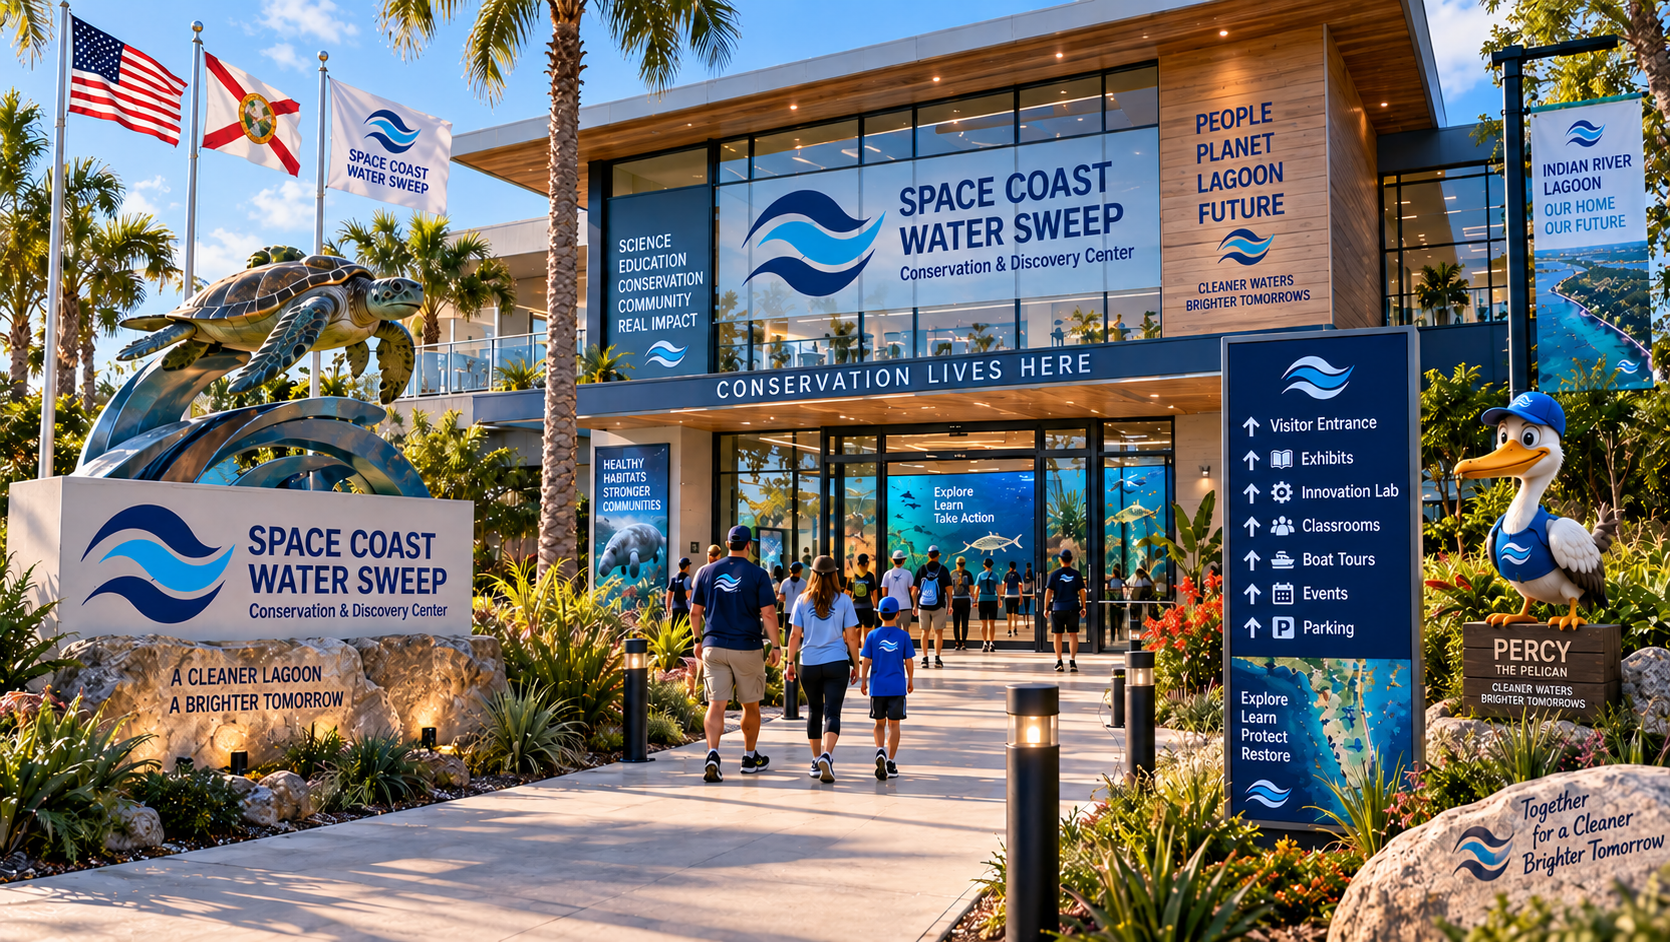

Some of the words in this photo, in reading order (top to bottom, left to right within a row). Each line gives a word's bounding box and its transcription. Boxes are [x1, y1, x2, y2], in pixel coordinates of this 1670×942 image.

[1196, 102, 1272, 134] PEOPLE
[1197, 132, 1274, 164] PLANET
[349, 148, 387, 170] SPACE
[390, 160, 429, 180] COAST
[1543, 159, 1589, 177] INDIAN
[1593, 154, 1631, 171] RIVER
[347, 164, 386, 186] WATER
[388, 175, 429, 194] SWEEP
[1198, 161, 1283, 194] LAGOON
[1544, 176, 1602, 195] LAGOON
[899, 177, 995, 216] SPACE
[1006, 161, 1112, 203] COAST
[1198, 193, 1284, 224] FUTURE
[1544, 200, 1571, 216] OUR
[1575, 197, 1615, 213] HOME
[900, 216, 1004, 255] WATER
[1014, 203, 1124, 243] SWEEP
[1545, 219, 1572, 235] OUR
[1575, 215, 1626, 232] FUTURE
[619, 234, 671, 253] SCIENCE
[619, 252, 687, 273] EDUCATION
[900, 259, 991, 281] Conservation
[996, 257, 1006, 271] &
[1011, 250, 1081, 271] Discovery
[1085, 245, 1135, 263] Center
[618, 270, 703, 294] CONSERVATION
[1198, 278, 1247, 295] CLEANER
[1250, 274, 1294, 290] WATERS
[618, 293, 692, 313] COMMUNITY
[1186, 294, 1237, 311] BRIGHTER
[1239, 289, 1310, 307] TOMORROWS
[618, 317, 648, 333] REAL
[651, 312, 697, 330] IMPACT
[717, 368, 910, 399] CONSERVATION
[927, 360, 1001, 383] LIVES
[1020, 354, 1092, 377] HERE
[1270, 418, 1314, 433] Visitor
[1318, 415, 1377, 430] Entrance
[604, 458, 644, 470] HEALTHY
[1301, 450, 1353, 466] Exhibits
[604, 472, 646, 483] HABITATS
[603, 486, 650, 498] STRONGER
[934, 487, 973, 499] Explore
[1302, 484, 1371, 499] Innovation
[1375, 483, 1398, 497] Lab
[603, 500, 661, 511] COMMUNITIES
[934, 500, 963, 510] Learn
[934, 513, 959, 524] Take
[961, 513, 994, 523] Action
[1302, 518, 1380, 532] Classrooms
[248, 525, 341, 557] SPACE
[351, 530, 436, 560] COAST
[1303, 553, 1333, 567] Boat
[1337, 551, 1375, 566] Tours
[249, 564, 348, 594] WATER
[357, 566, 447, 595] SWEEP
[1303, 586, 1348, 600] Events
[249, 602, 335, 619] Conservation
[340, 603, 349, 618] &
[353, 603, 407, 620] Discovery
[412, 603, 447, 617] Center
[1303, 620, 1354, 638] Parking
[1494, 638, 1571, 662] PERCY
[171, 668, 182, 686] A
[188, 667, 257, 686] CLEANER
[263, 666, 322, 683] LAGOON
[1495, 665, 1516, 675] THE
[1520, 665, 1568, 677] PELICAN
[1492, 683, 1532, 693] CLEANER
[1536, 685, 1572, 695] WATERS
[169, 695, 180, 714] A
[186, 693, 258, 713] BRIGHTER
[263, 691, 344, 710] TOMORROW
[1241, 691, 1288, 708] Explore
[1481, 694, 1524, 705] BRIGHTER
[1527, 697, 1585, 708] TOMORROWS
[1241, 711, 1276, 724] Learn
[1241, 729, 1287, 743] Protect
[1242, 747, 1290, 762] Restore
[1521, 790, 1589, 823] Together
[1532, 824, 1555, 849] for
[1558, 826, 1569, 839] a
[1573, 812, 1634, 836] Cleaner
[1522, 846, 1586, 877] Brighter
[1587, 834, 1664, 861] Tomorrow
